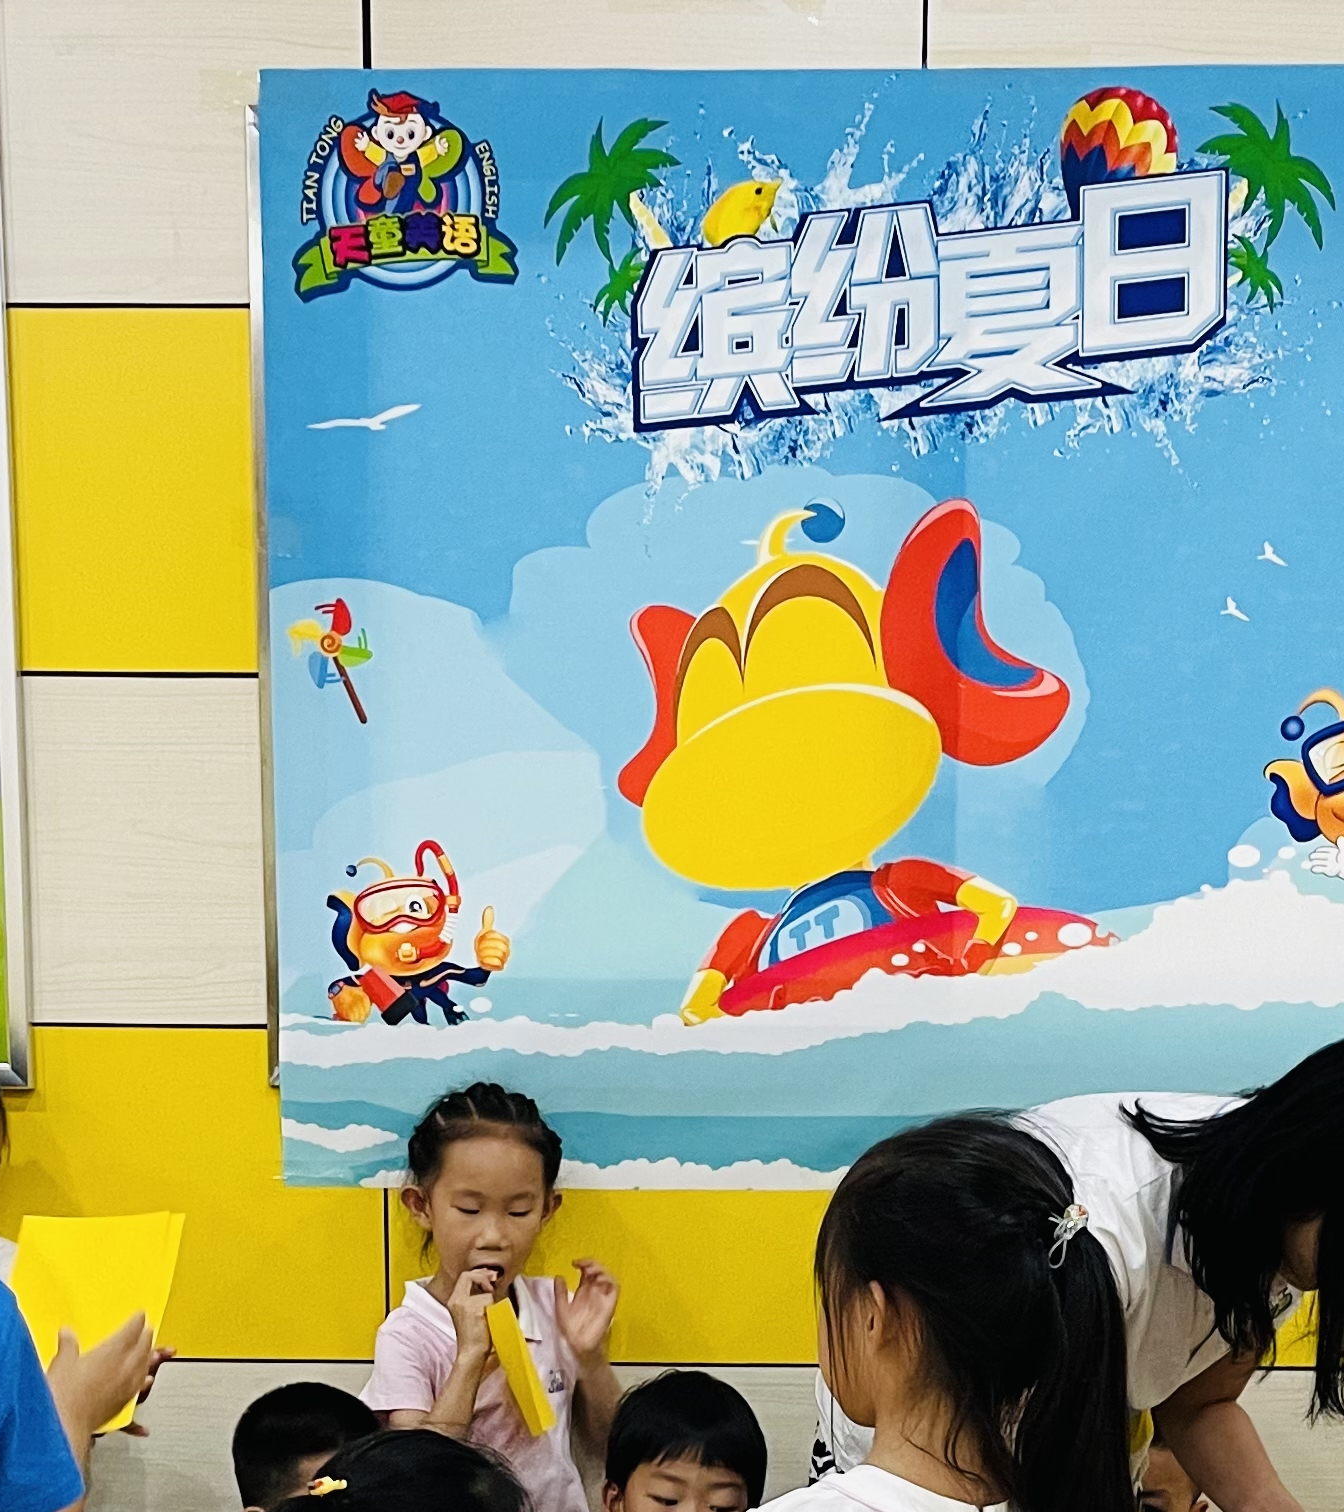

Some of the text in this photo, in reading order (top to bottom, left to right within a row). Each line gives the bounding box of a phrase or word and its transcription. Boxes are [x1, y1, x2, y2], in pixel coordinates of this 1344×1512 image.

[301, 115, 345, 223] TIAN TONG
[473, 140, 500, 219] ENGLISH
[330, 213, 480, 269] 天童美语
[633, 170, 1229, 430] 缤纷夏日
[789, 904, 840, 952] TT
